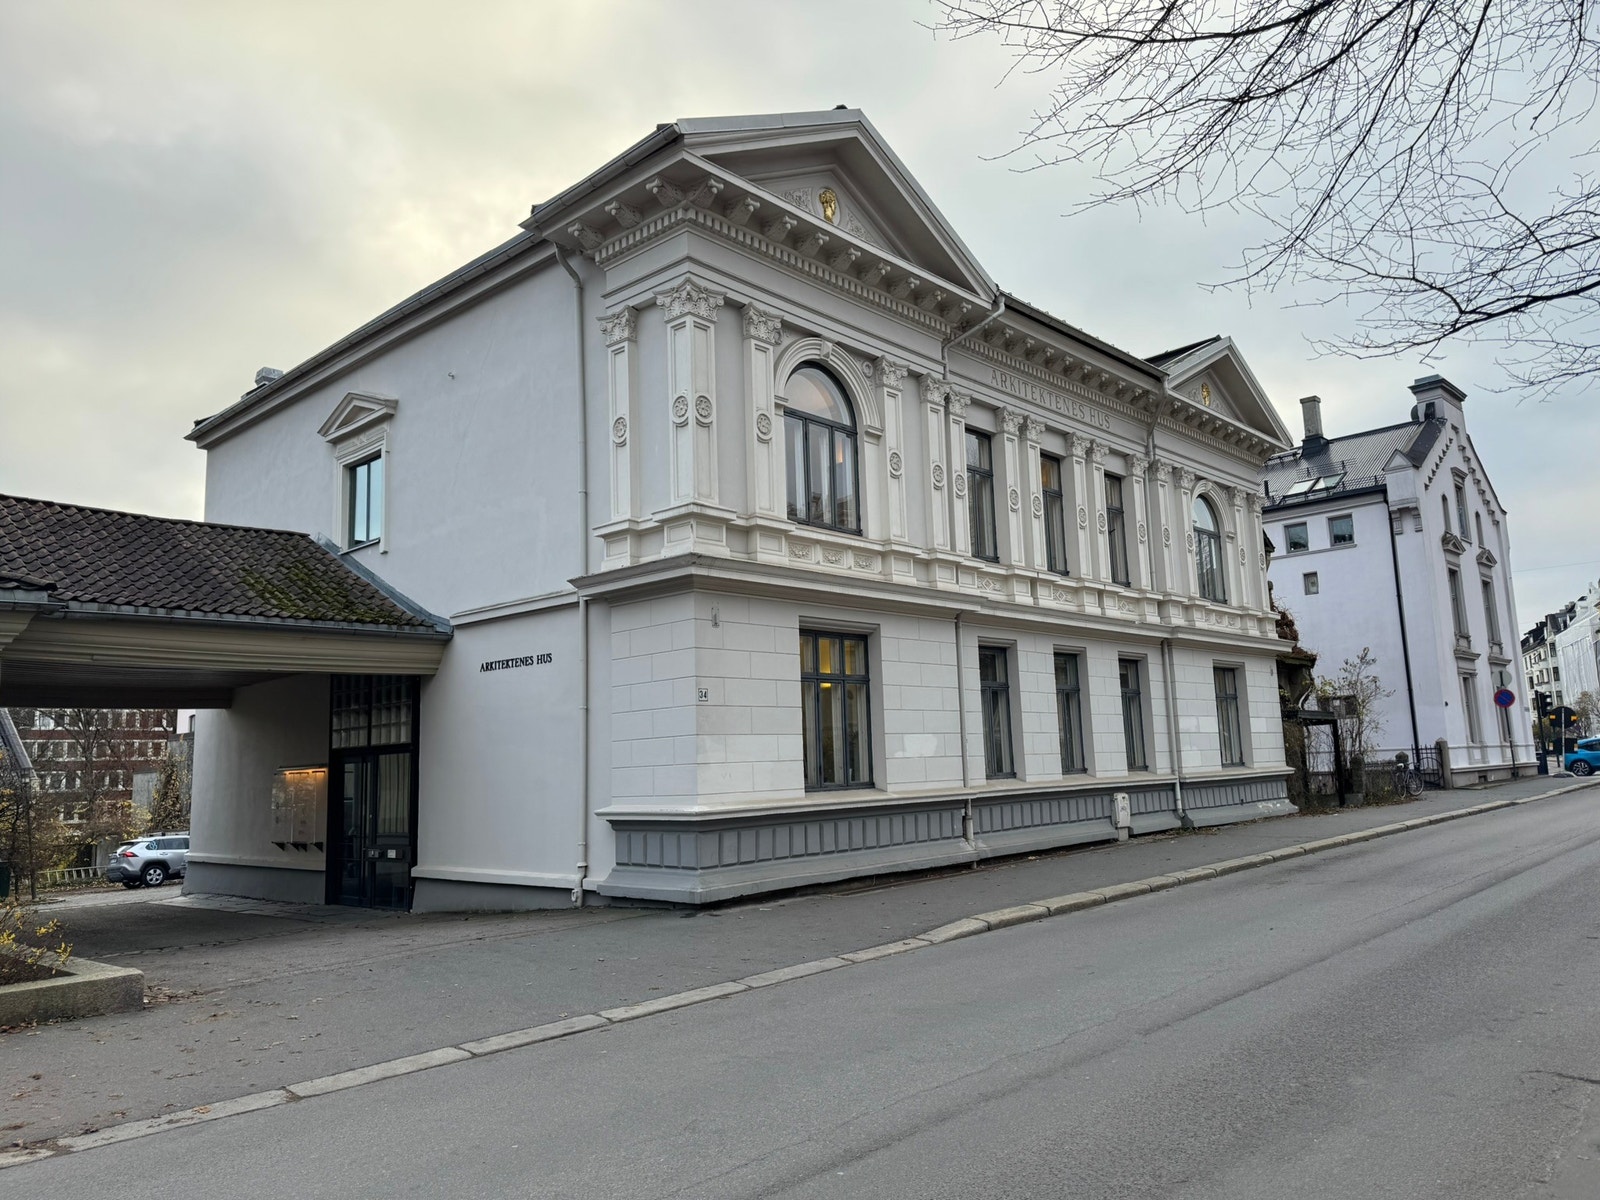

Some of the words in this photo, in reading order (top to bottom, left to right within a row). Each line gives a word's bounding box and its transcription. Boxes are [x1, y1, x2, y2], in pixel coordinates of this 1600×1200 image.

[990, 369, 1085, 420] ARKITEKTENES
[1089, 410, 1111, 430] HUS
[479, 655, 534, 673] ARKITEKTENES
[536, 652, 553, 665] HUS
[699, 690, 707, 699] 34
